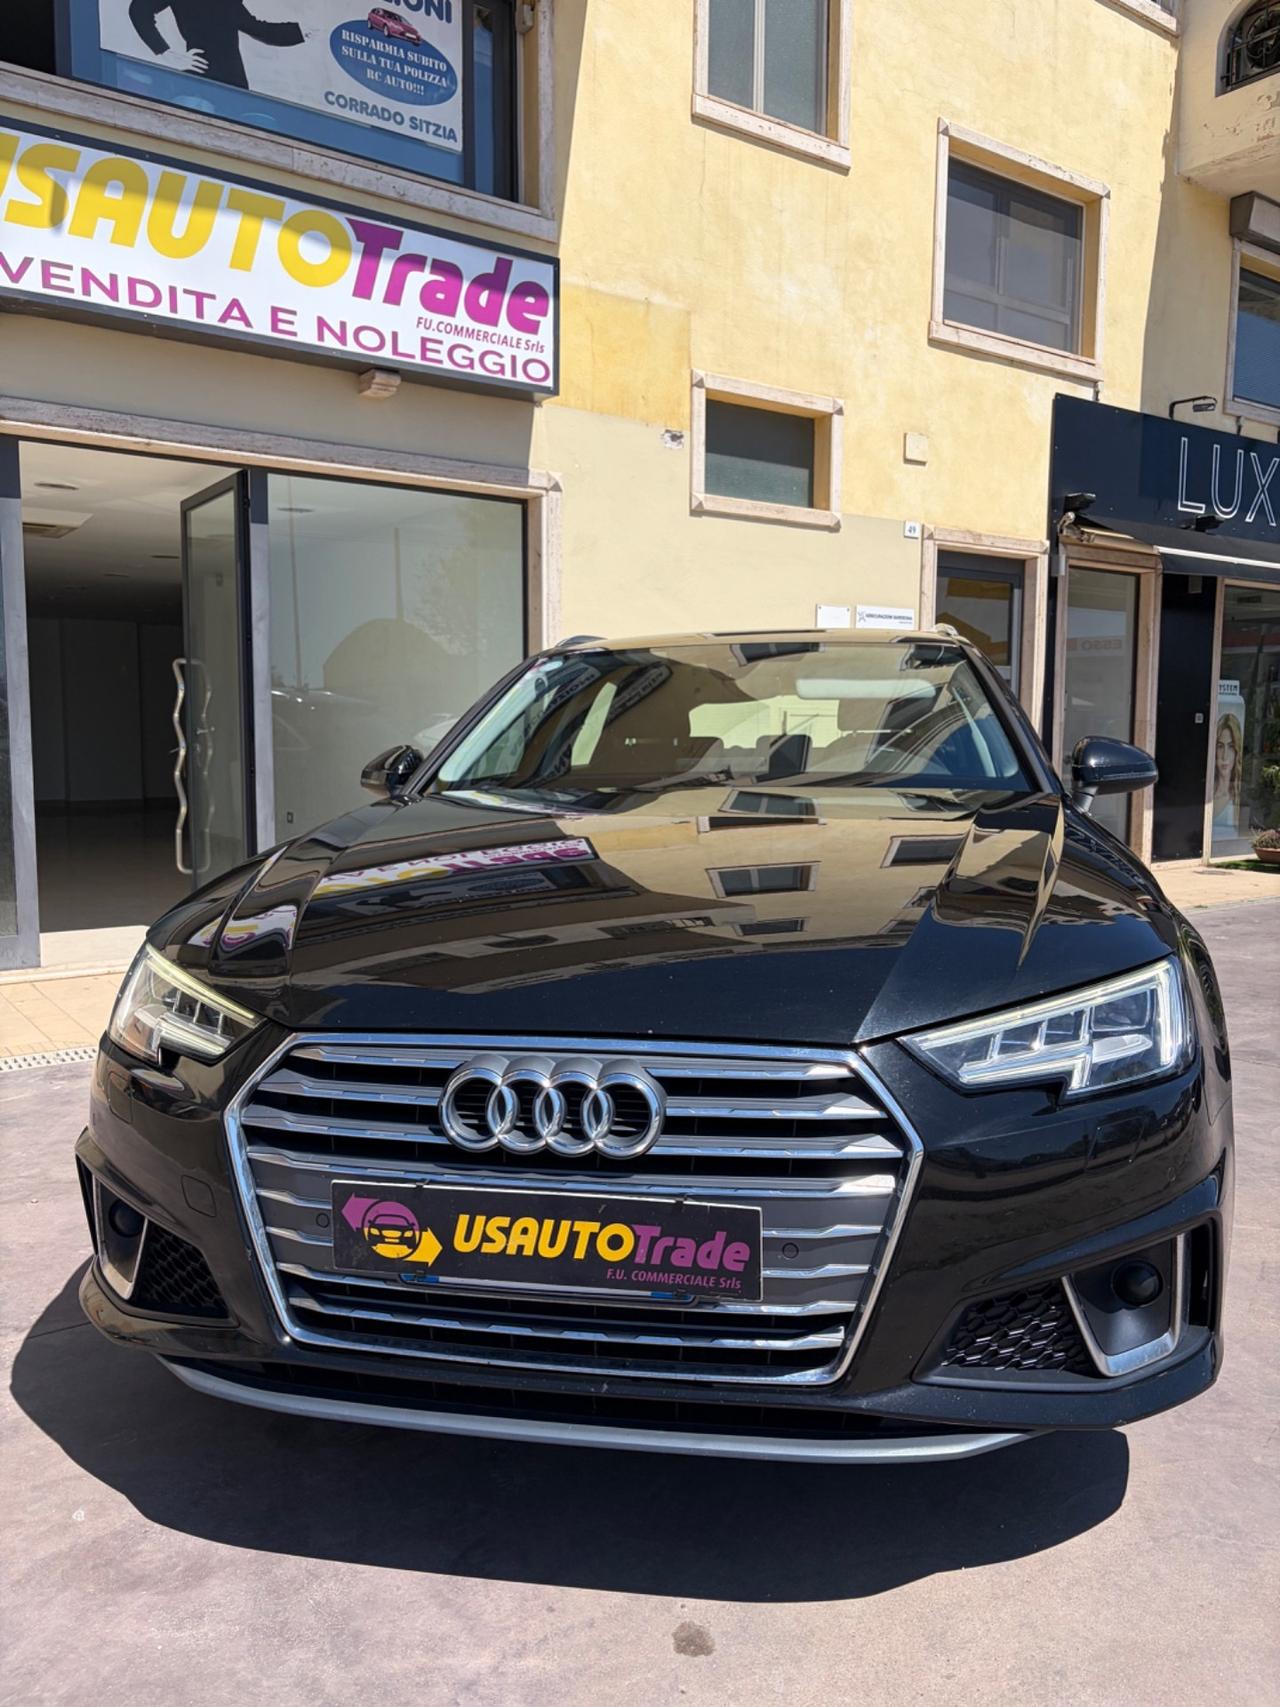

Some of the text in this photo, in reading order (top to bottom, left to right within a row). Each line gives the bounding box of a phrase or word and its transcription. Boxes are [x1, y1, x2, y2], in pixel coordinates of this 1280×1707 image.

[342, 29, 447, 72] RISPARMIA SUBITO
[342, 45, 447, 87] SULLA TUA POLIZZA
[367, 69, 424, 95] RC AUTO!!!
[324, 91, 458, 143] CORRADO SITZIA
[0, 251, 551, 383] VENDITA E NOLEGGIO
[523, 339, 546, 354] Srls
[1177, 436, 1280, 527] LUX
[606, 1268, 742, 1290] F.U. COMMERCIALE Srls
